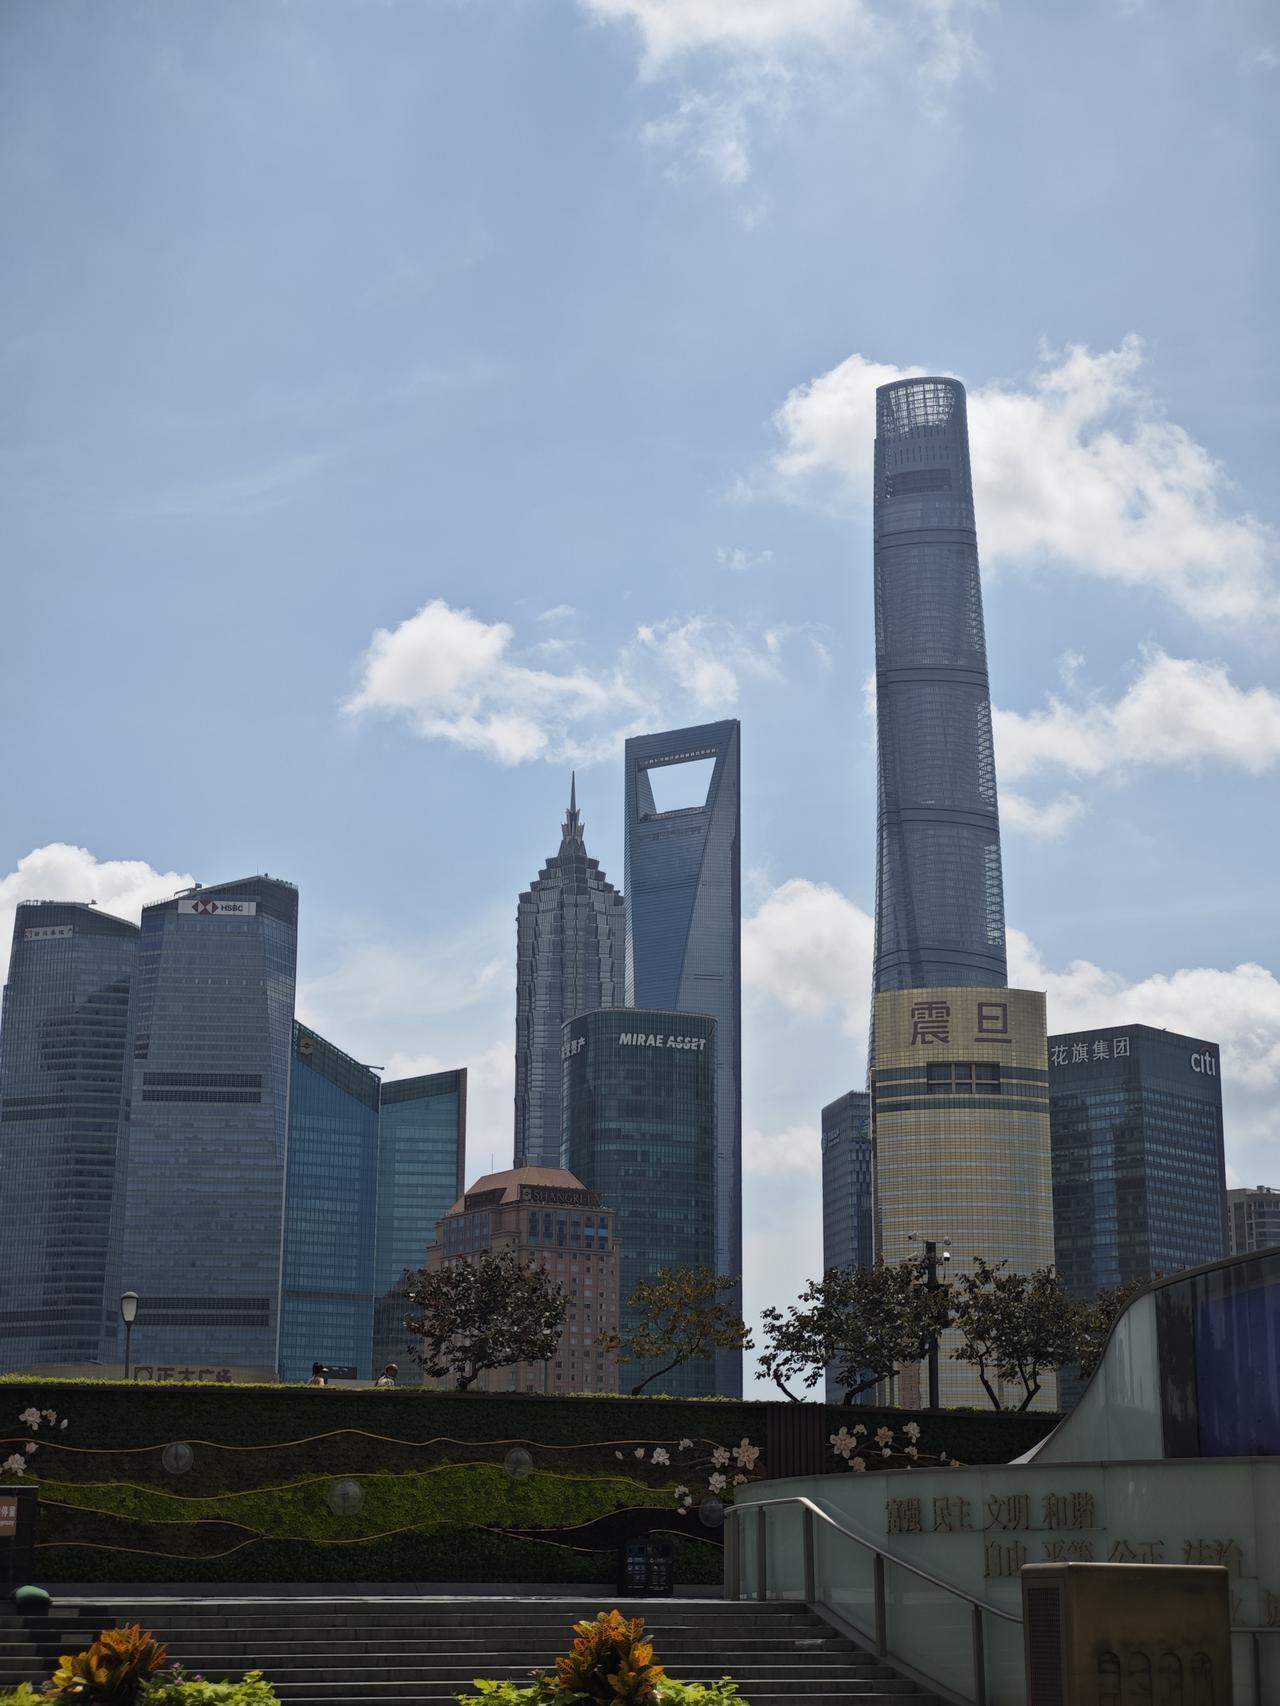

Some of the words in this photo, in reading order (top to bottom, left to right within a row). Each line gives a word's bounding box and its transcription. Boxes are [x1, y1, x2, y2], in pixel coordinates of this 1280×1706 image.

[221, 904, 244, 912] HSBC
[911, 1001, 1012, 1045] 震旦
[618, 1033, 664, 1047] MIRAE
[666, 1036, 706, 1051] ASSET
[1051, 1036, 1130, 1067] 花旗集团
[1191, 1051, 1216, 1076] citi
[157, 1367, 232, 1382] 正大广场
[931, 1495, 974, 1532] 民主
[984, 1494, 1030, 1531] 文明
[1040, 1492, 1095, 1530] 和谐
[984, 1540, 1027, 1578] 自由
